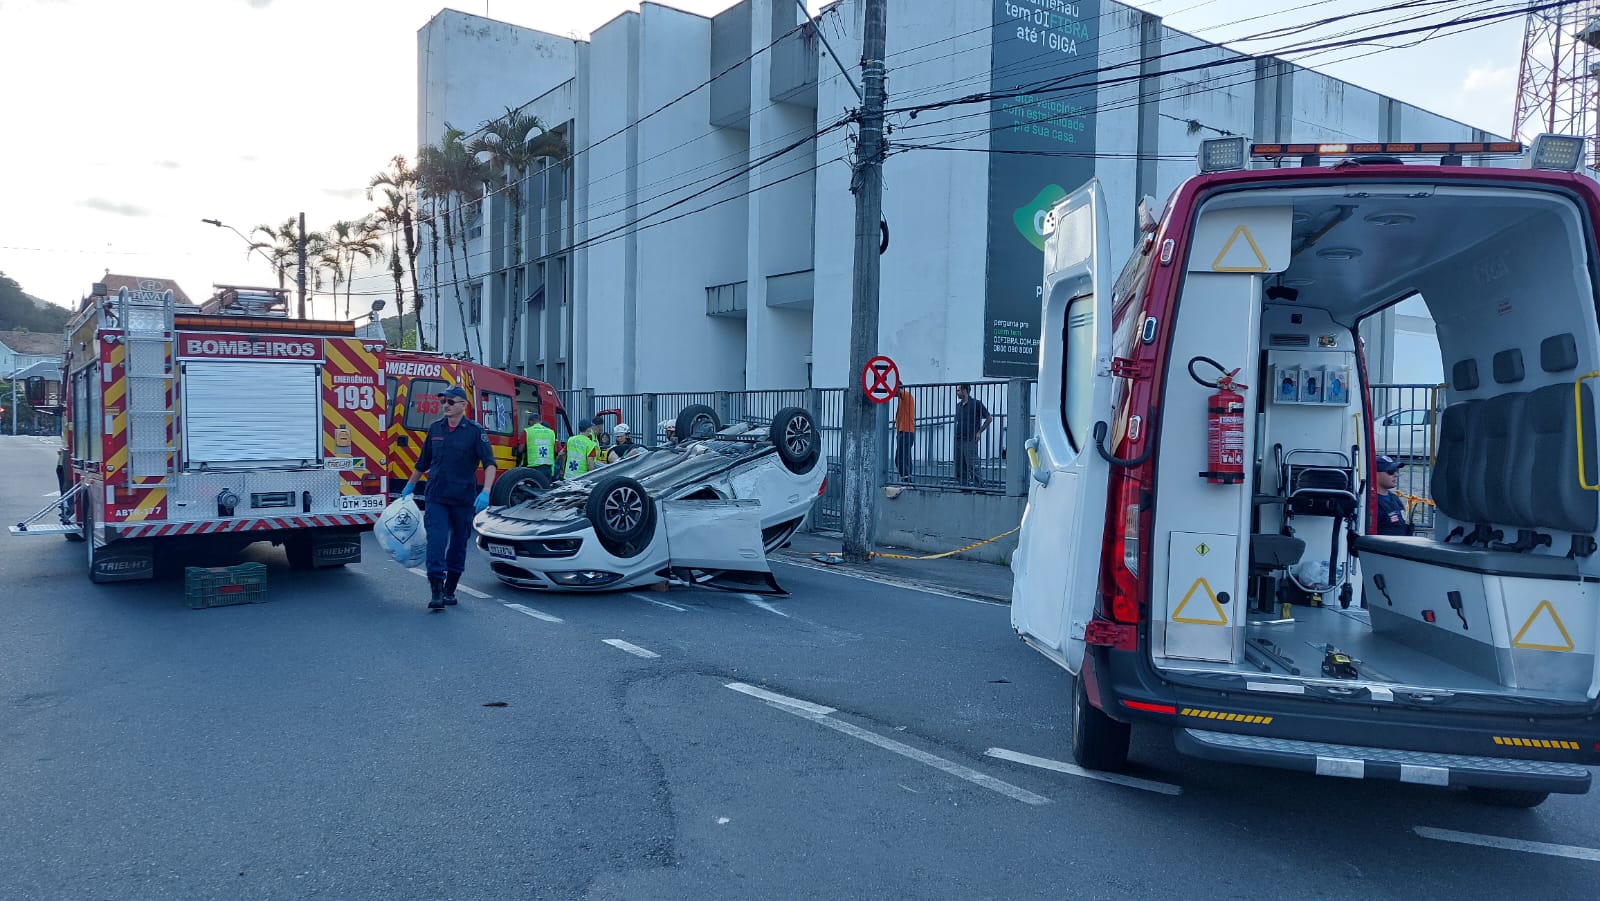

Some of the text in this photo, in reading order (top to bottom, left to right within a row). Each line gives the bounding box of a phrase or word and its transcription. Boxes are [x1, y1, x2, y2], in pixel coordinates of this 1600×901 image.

[1005, 0, 1089, 39] tem OIFIBRA
[1016, 26, 1078, 56] até 1 GIGA
[1002, 103, 1025, 117] com
[1014, 120, 1077, 144] pra sua casa.
[186, 339, 316, 357] BOMBEIROS
[386, 361, 441, 377] MBEIROS
[333, 374, 374, 384] EMERGÊNCIA
[333, 385, 374, 410] 193
[361, 499, 384, 509] 3994
